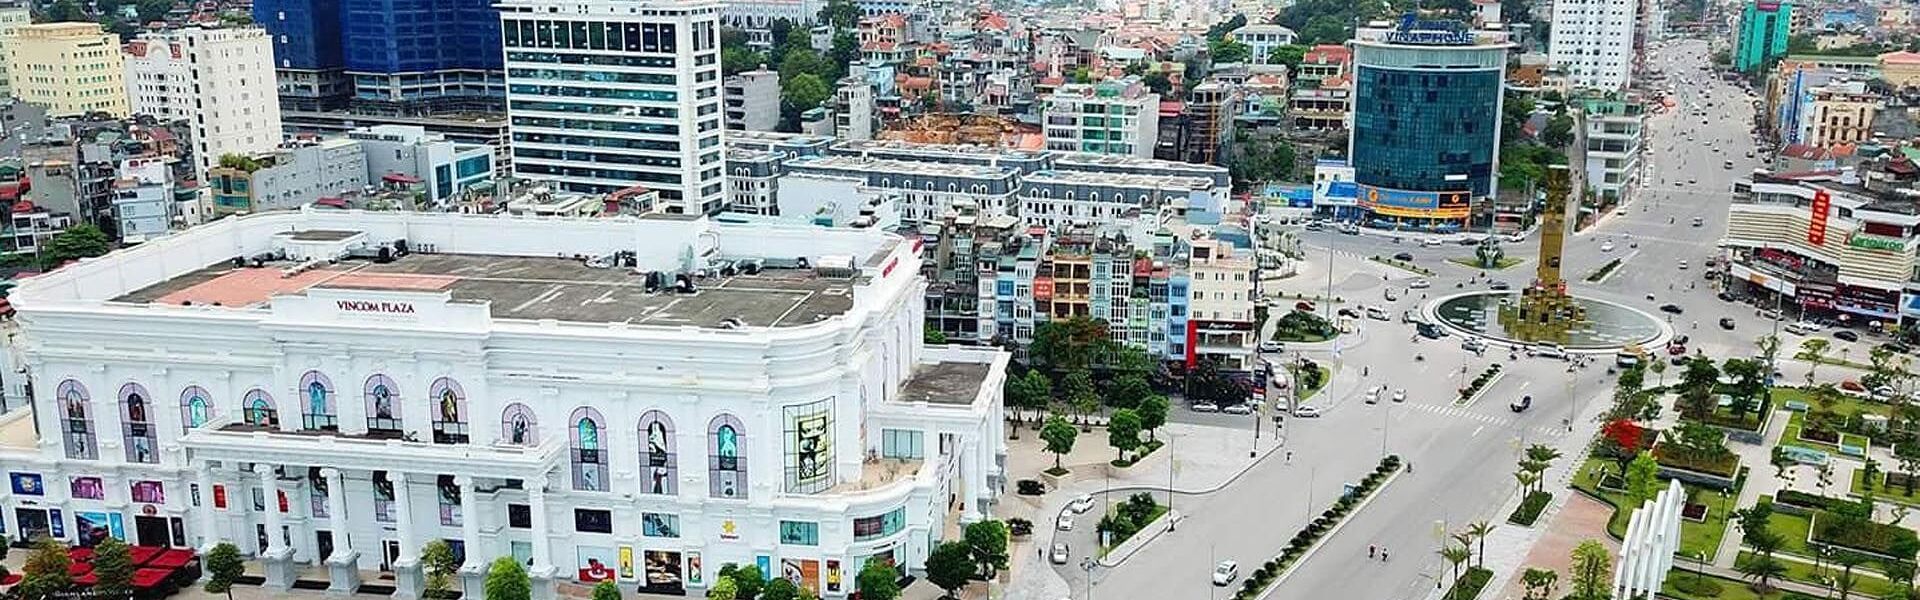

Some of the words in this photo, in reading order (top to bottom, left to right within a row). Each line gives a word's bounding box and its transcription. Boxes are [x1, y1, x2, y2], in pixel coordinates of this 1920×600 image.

[1385, 30, 1474, 43] VINAPHONE
[337, 300, 380, 312] VINCOM
[381, 302, 414, 314] PLAZA
